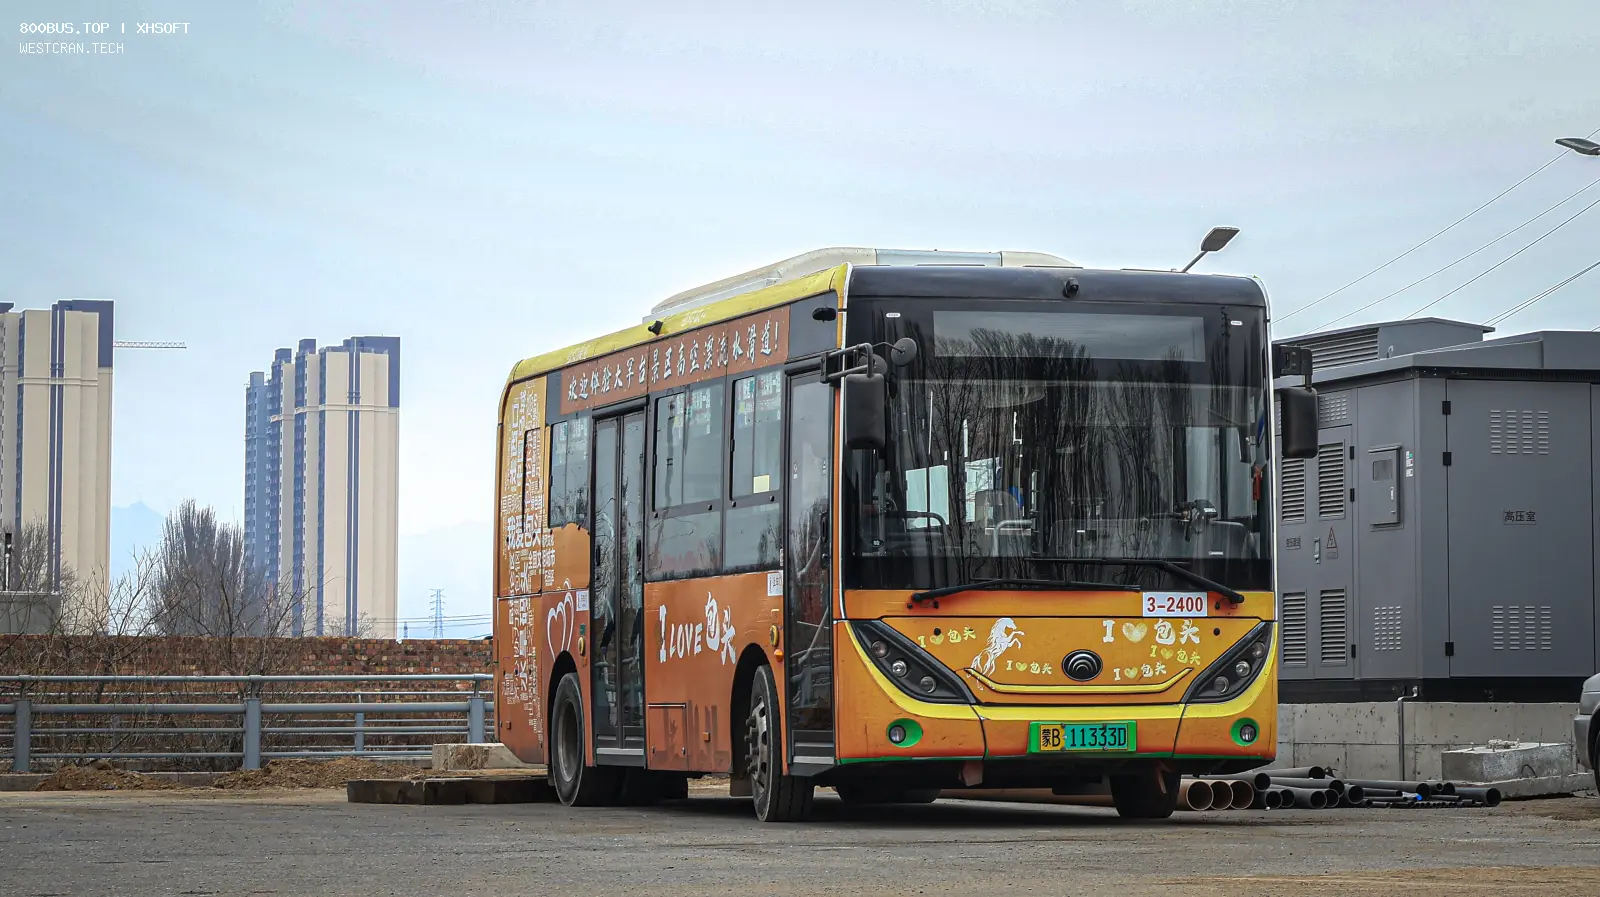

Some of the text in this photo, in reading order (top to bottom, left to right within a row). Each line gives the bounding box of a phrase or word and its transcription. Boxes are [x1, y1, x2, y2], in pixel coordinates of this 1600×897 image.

[1504, 510, 1536, 522] 高压室
[1146, 596, 1204, 613] 3-2400
[669, 622, 703, 659] LOVE
[705, 591, 737, 665] 包头
[947, 625, 976, 643] 包头
[1102, 618, 1200, 645] I 包头
[1176, 648, 1200, 666] 包头
[1030, 661, 1052, 675] 包头
[1141, 661, 1167, 678] 包头
